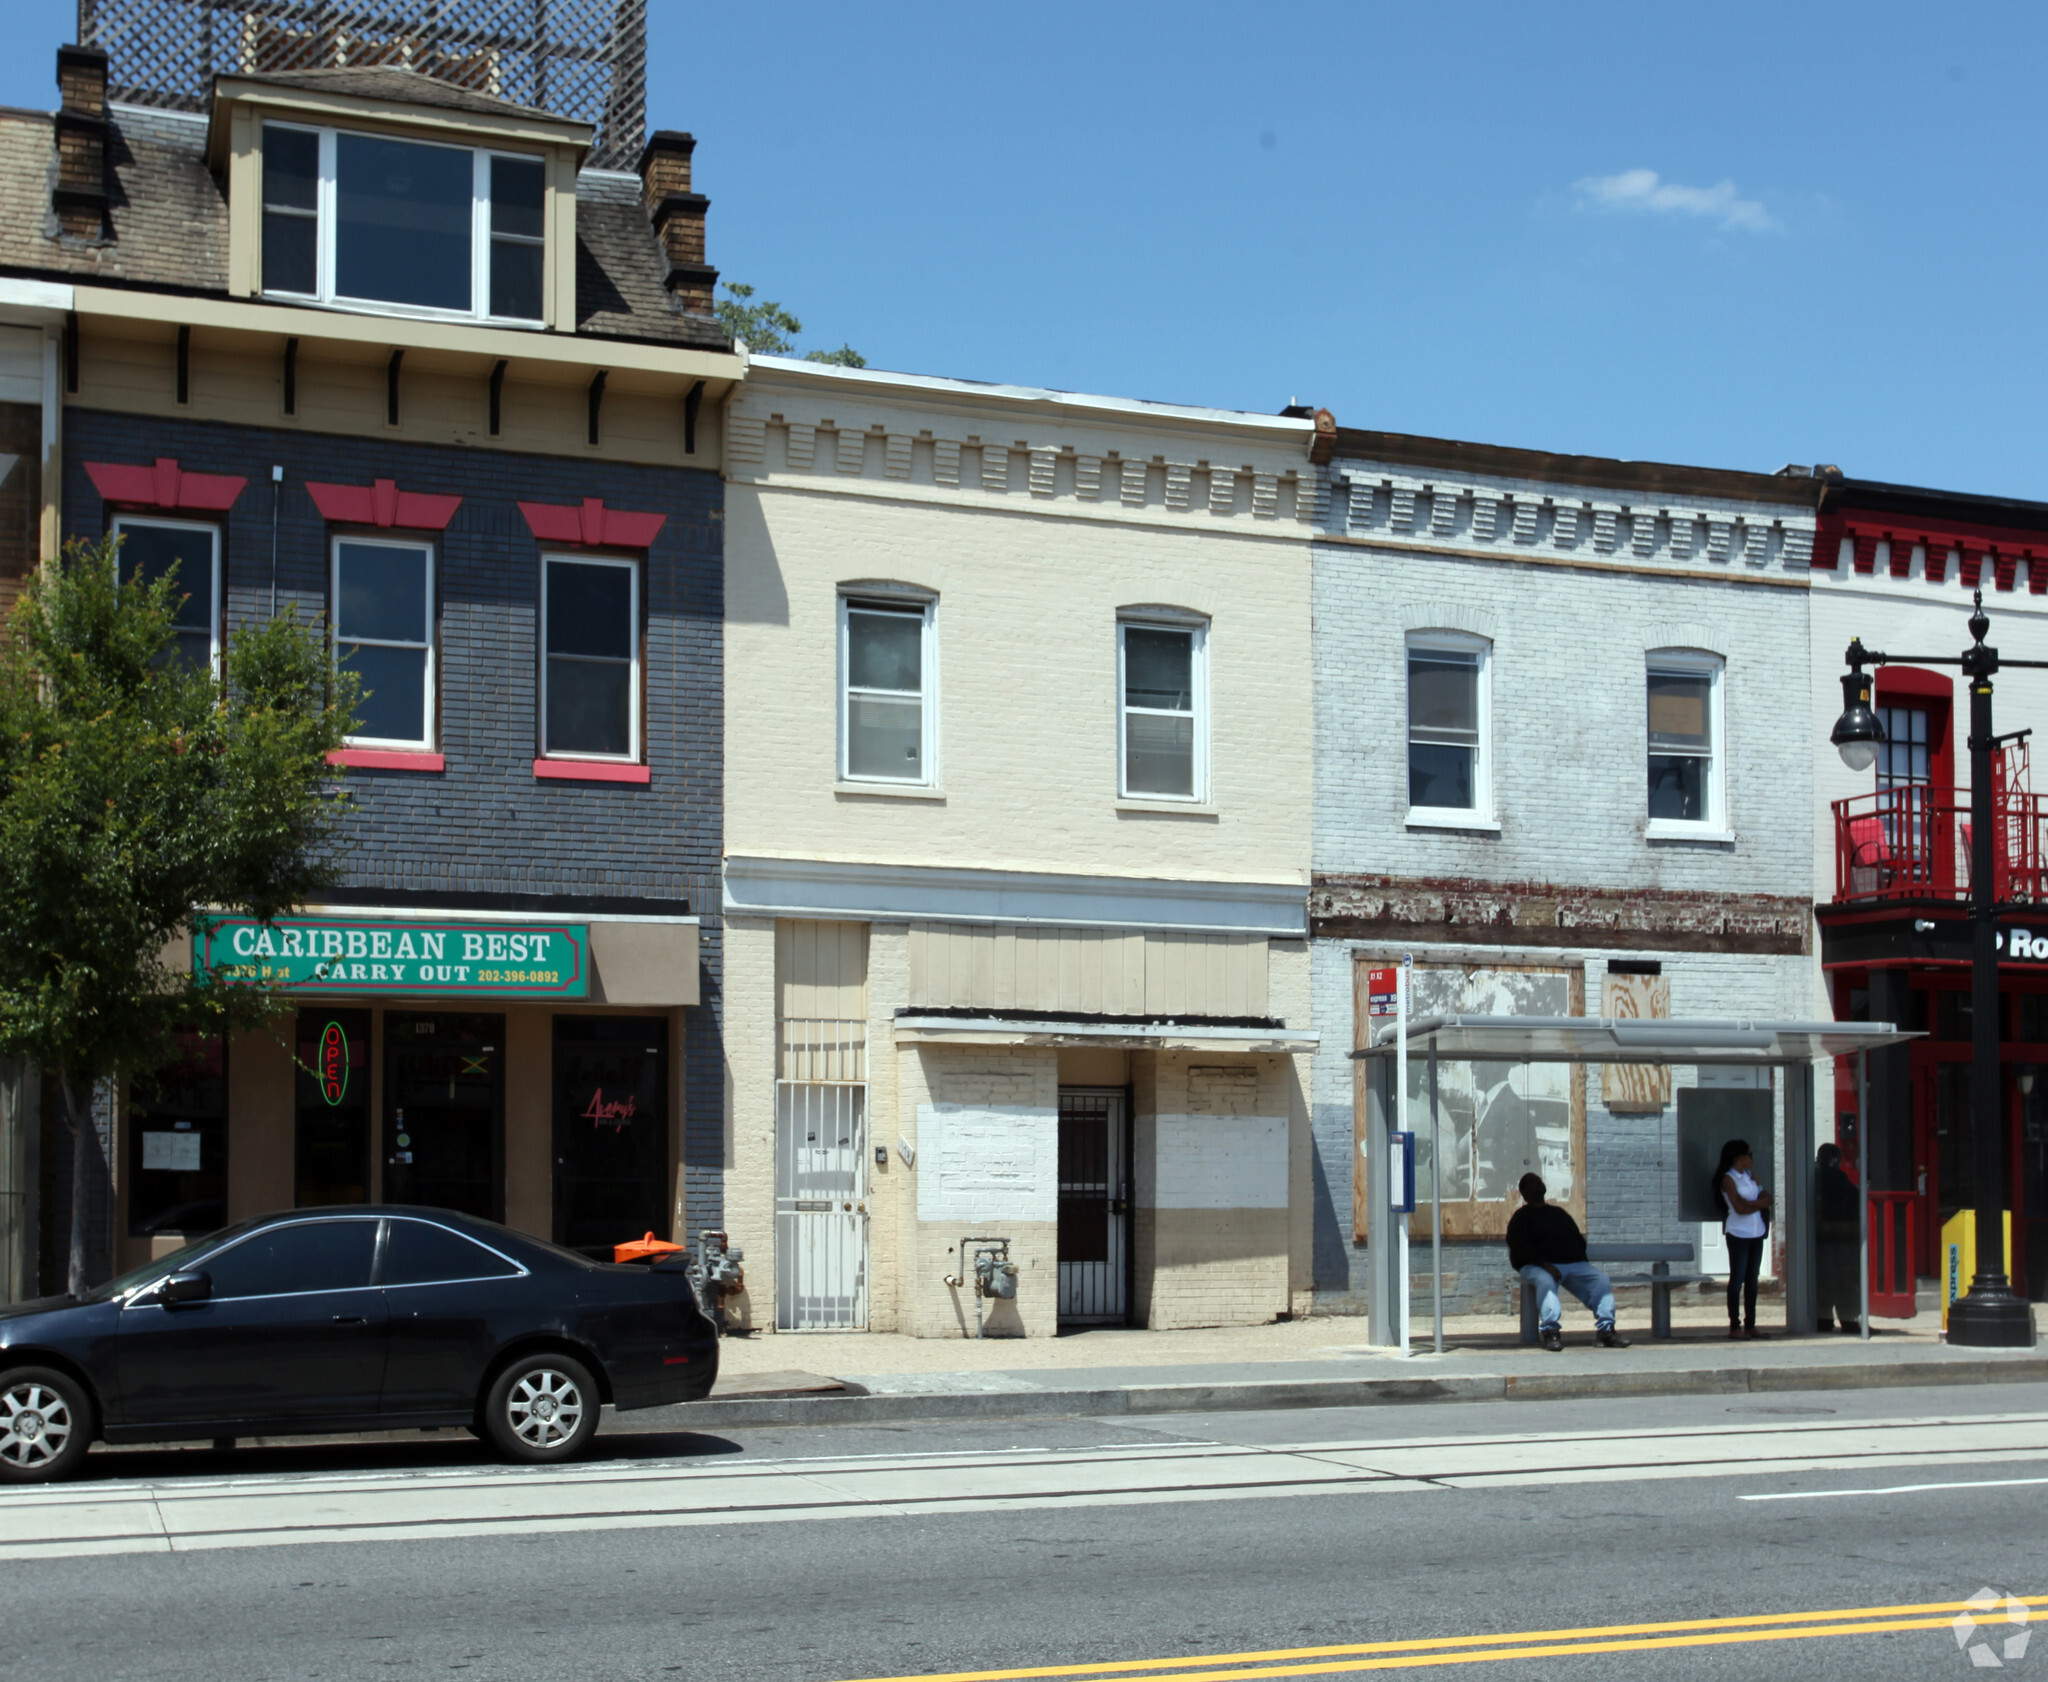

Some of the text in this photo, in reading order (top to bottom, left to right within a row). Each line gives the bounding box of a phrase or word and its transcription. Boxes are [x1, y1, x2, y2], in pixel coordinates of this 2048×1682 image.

[233, 927, 550, 962] CARIBBEAN BEST
[262, 966, 271, 978] H
[314, 963, 470, 982] CARRY OUT
[477, 969, 559, 983] 202-396-0892
